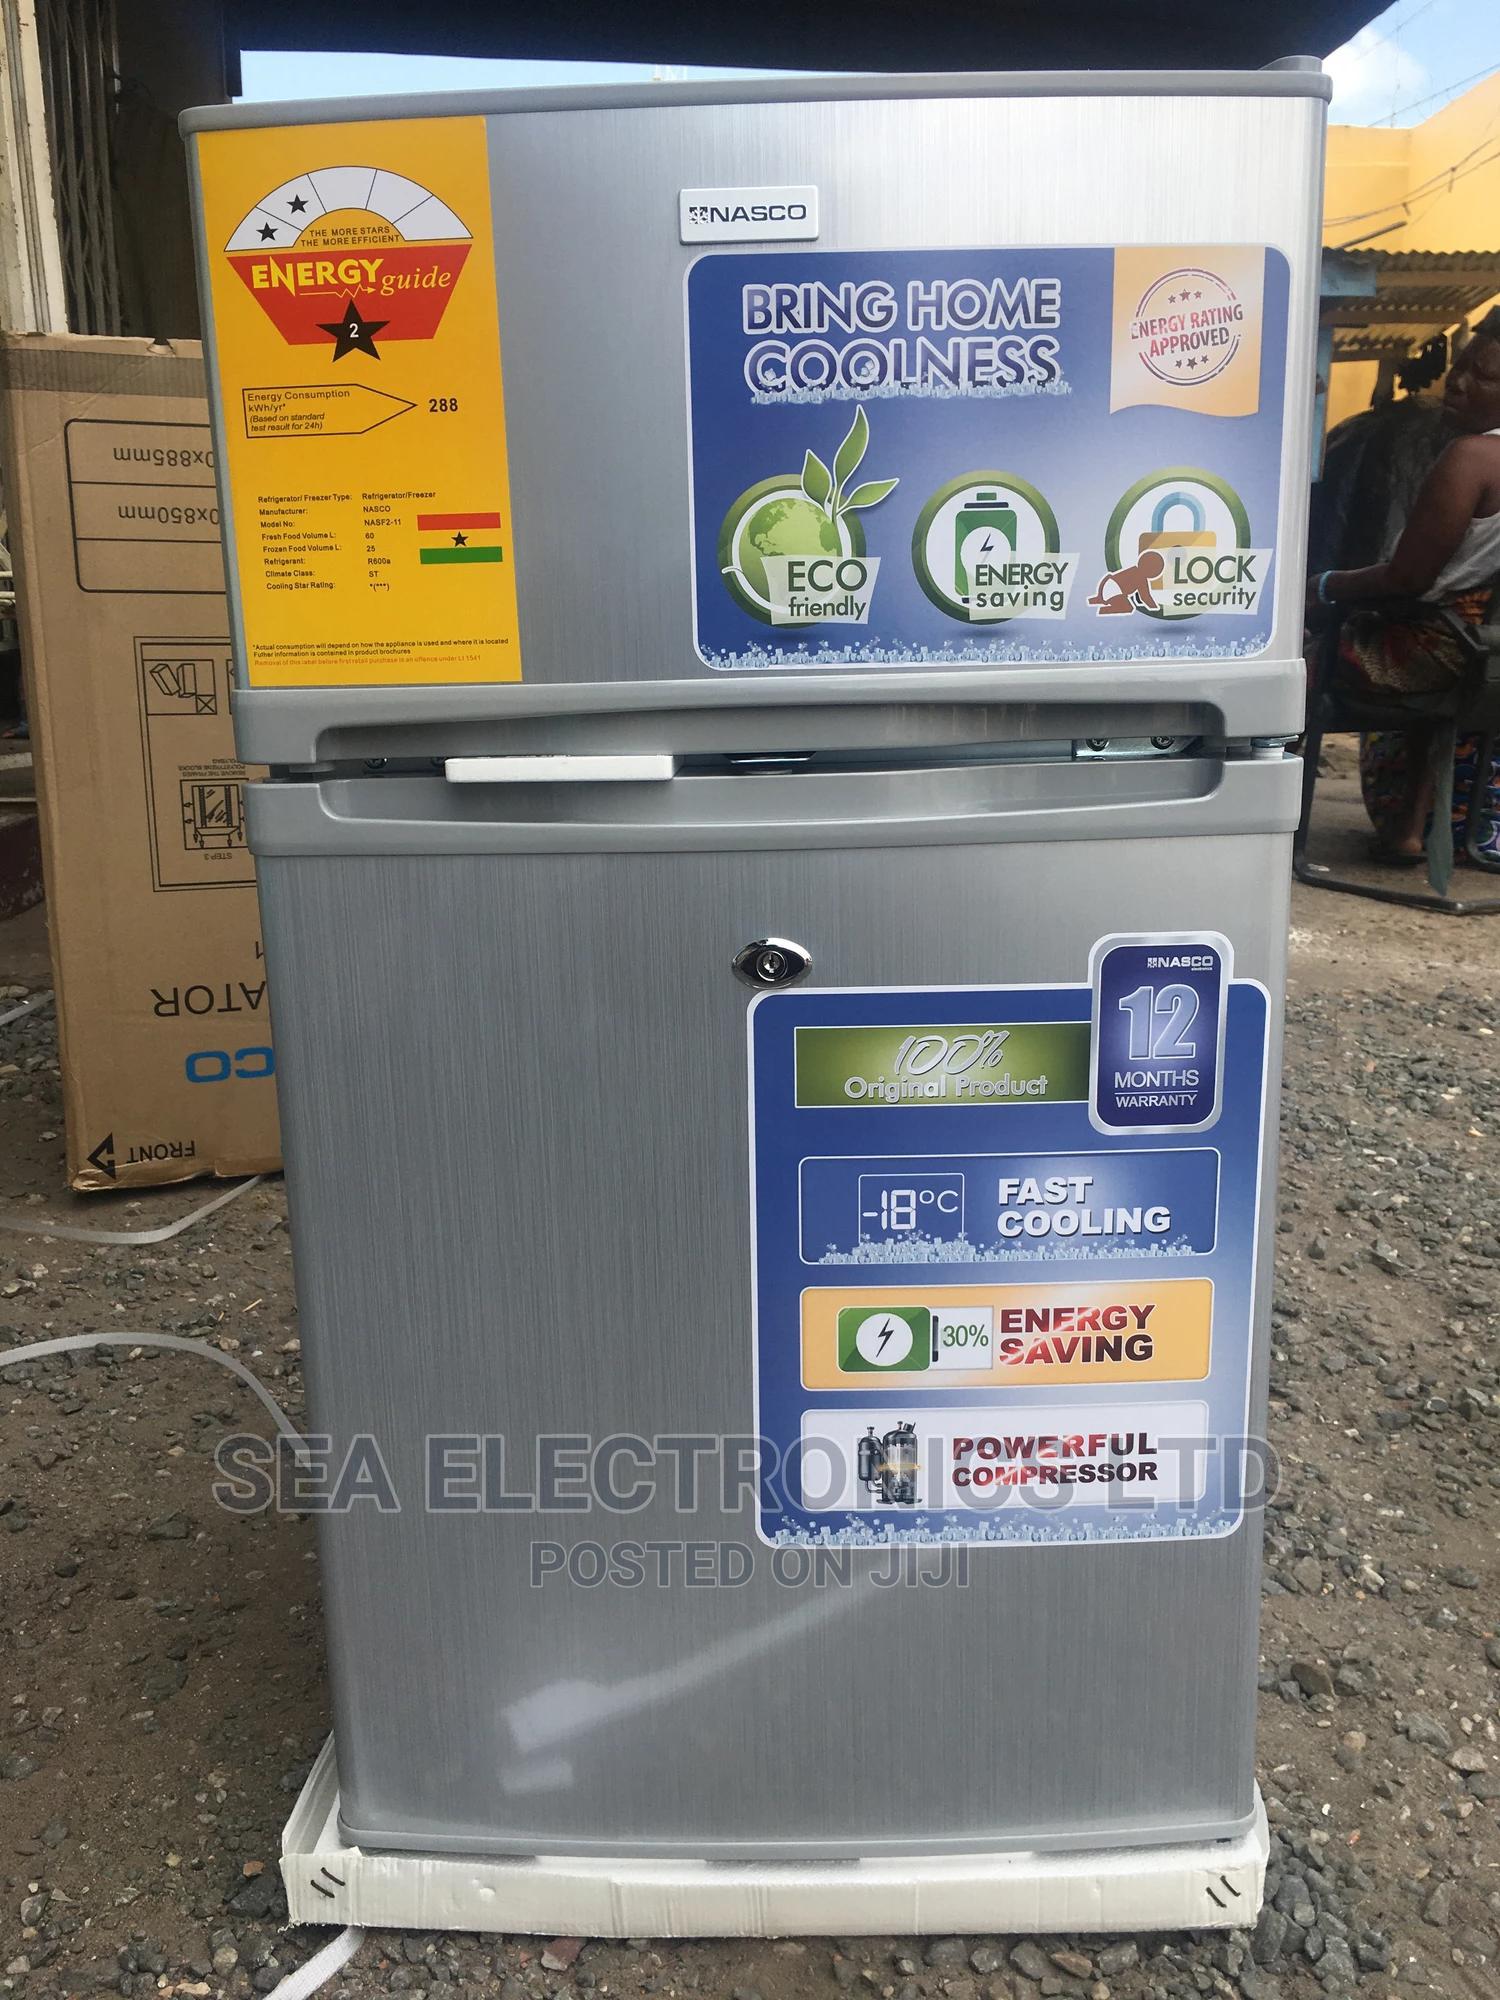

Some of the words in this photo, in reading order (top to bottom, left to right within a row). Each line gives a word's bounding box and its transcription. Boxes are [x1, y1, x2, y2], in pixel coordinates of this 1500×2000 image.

[710, 204, 807, 223] NASCO
[300, 238, 319, 247] THE
[322, 237, 351, 246] MORE
[351, 234, 400, 245] EFFICIENT
[309, 229, 328, 238] THE
[331, 227, 358, 237] MORE
[360, 225, 390, 235] STARS
[251, 255, 384, 297] ENERGY
[380, 265, 451, 297] guide
[743, 280, 898, 336] BRING
[907, 278, 1061, 331] HOME
[1190, 303, 1244, 329] RATING
[349, 323, 360, 338] 2
[1149, 326, 1230, 358] APPROVED
[745, 335, 1060, 397] COOLNESS
[247, 392, 282, 403] Energy
[284, 389, 350, 401] Consumption
[428, 398, 459, 413] 288
[250, 414, 279, 424] (Based
[290, 413, 325, 421] standard
[267, 423, 290, 431] result
[304, 421, 323, 431] 24h)
[304, 494, 332, 502] Freezer
[332, 493, 352, 502] Type:
[362, 492, 436, 501] Refrigerator/Freezer
[259, 508, 308, 516] Manufacturer:
[363, 505, 391, 513] NASCO
[283, 520, 295, 528] No:
[364, 518, 402, 527] NASF2-11
[261, 533, 282, 541] Fresh
[283, 532, 301, 540] Food
[365, 532, 375, 540] 60
[262, 545, 287, 553] Frozen
[307, 544, 334, 552] Volume
[264, 557, 306, 566] Refrigerant:
[367, 557, 391, 565] R600a
[1173, 554, 1257, 585] LOCK
[293, 569, 316, 577] Class:
[368, 570, 379, 578] ST
[786, 559, 868, 593] ECO
[975, 561, 1069, 587] ENERGY
[266, 582, 293, 590] Cooling
[294, 581, 310, 589] Star
[310, 581, 336, 590] Rating:
[975, 585, 1066, 611] saving
[1172, 585, 1257, 610] security
[787, 596, 867, 621] friendly
[275, 643, 315, 651] consumption
[327, 642, 351, 650] depend
[385, 640, 416, 648] appliance
[211, 852, 233, 860] STEP
[1157, 955, 1214, 968] NASCO
[150, 980, 266, 1017] ATOR
[1118, 983, 1200, 1061] 12
[894, 1029, 1011, 1076] 100%
[185, 1046, 276, 1084] CO
[844, 1074, 948, 1104] Original
[954, 1072, 1049, 1098] Product
[1113, 1069, 1200, 1090] MONTHS
[1114, 1094, 1198, 1109] WARRANTY
[126, 1140, 196, 1164] FRONT
[997, 1175, 1093, 1205] FAST
[996, 1206, 1171, 1237] COOLING
[999, 1303, 1156, 1335] ENERGY
[942, 1323, 989, 1349] 30%
[999, 1333, 1154, 1366] SAVING
[951, 1431, 1158, 1460] POWERFUL
[951, 1460, 1158, 1487] COMPRESSOR
